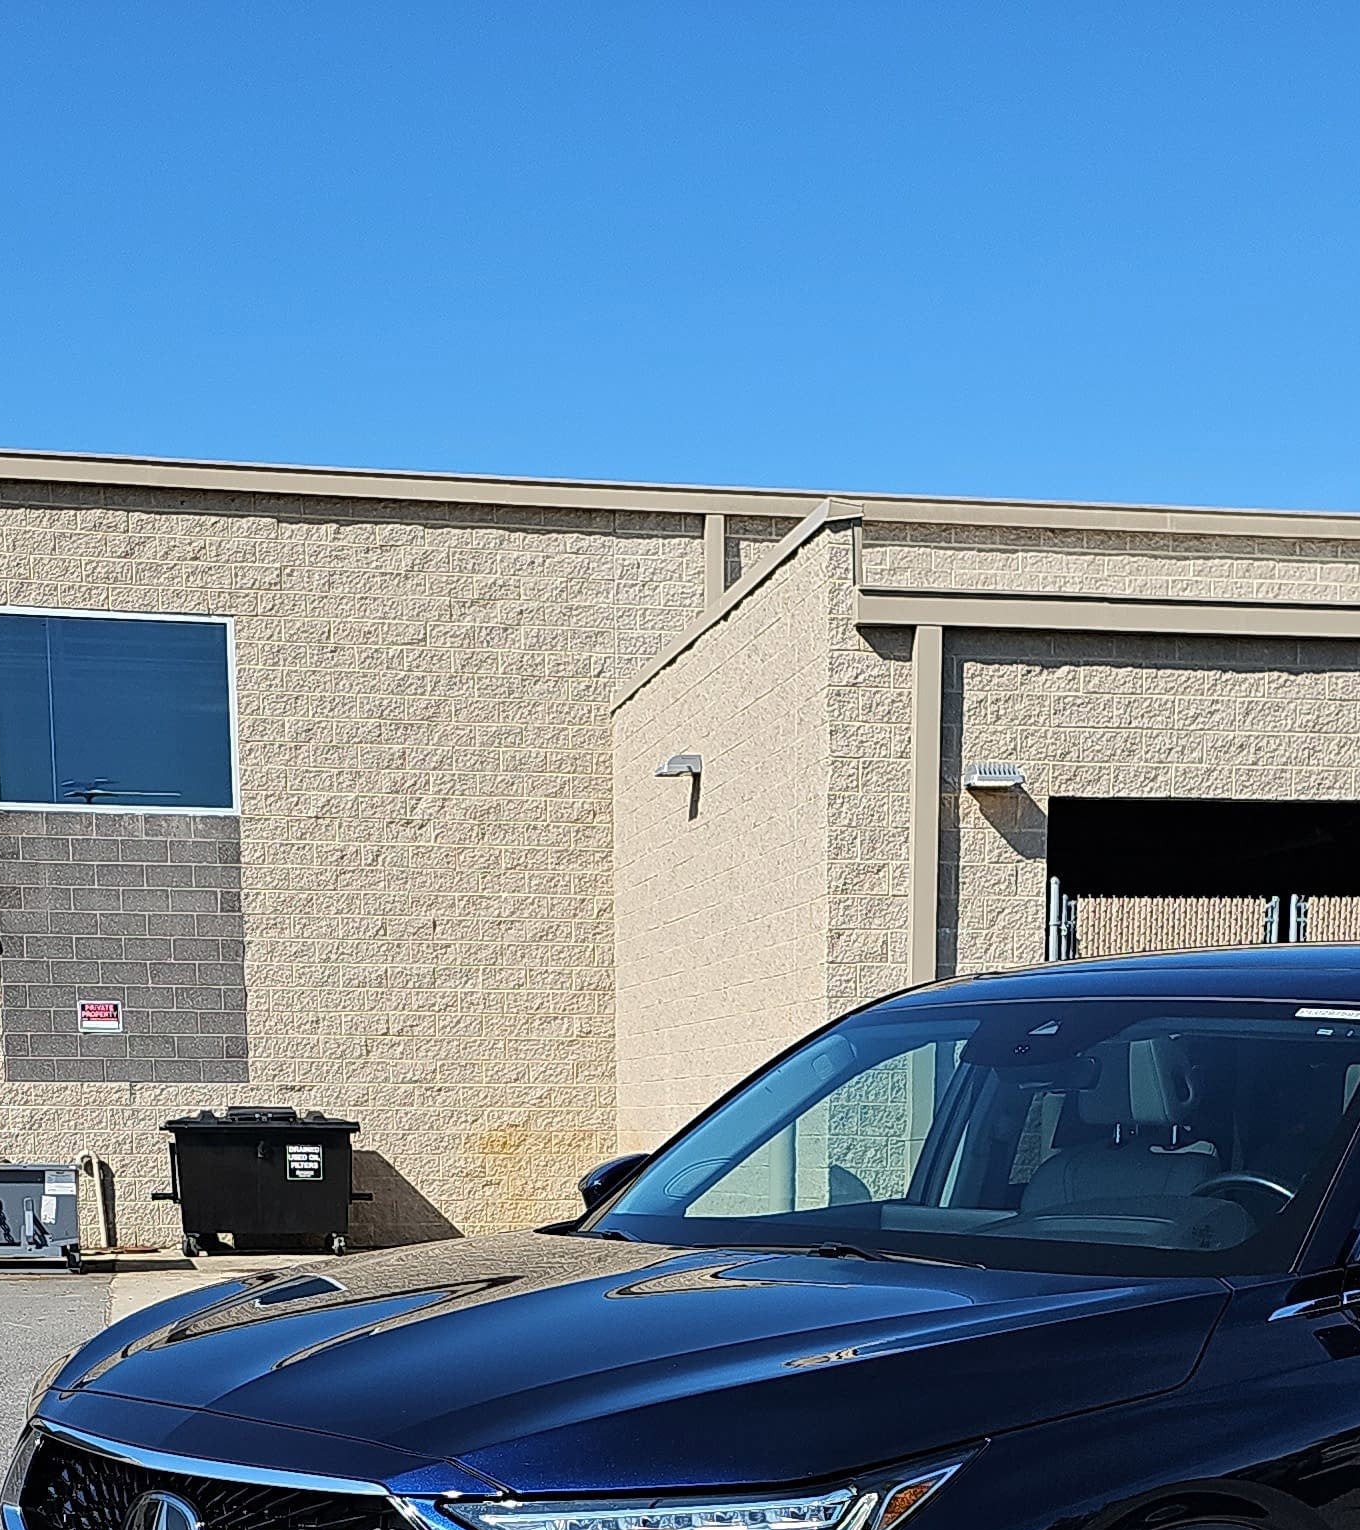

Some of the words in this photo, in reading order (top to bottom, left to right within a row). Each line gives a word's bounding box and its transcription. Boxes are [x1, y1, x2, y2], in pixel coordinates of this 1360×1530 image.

[81, 1010, 118, 1018] PROPERTY
[288, 1153, 308, 1161] USED
[290, 1161, 319, 1169] FILTERS
